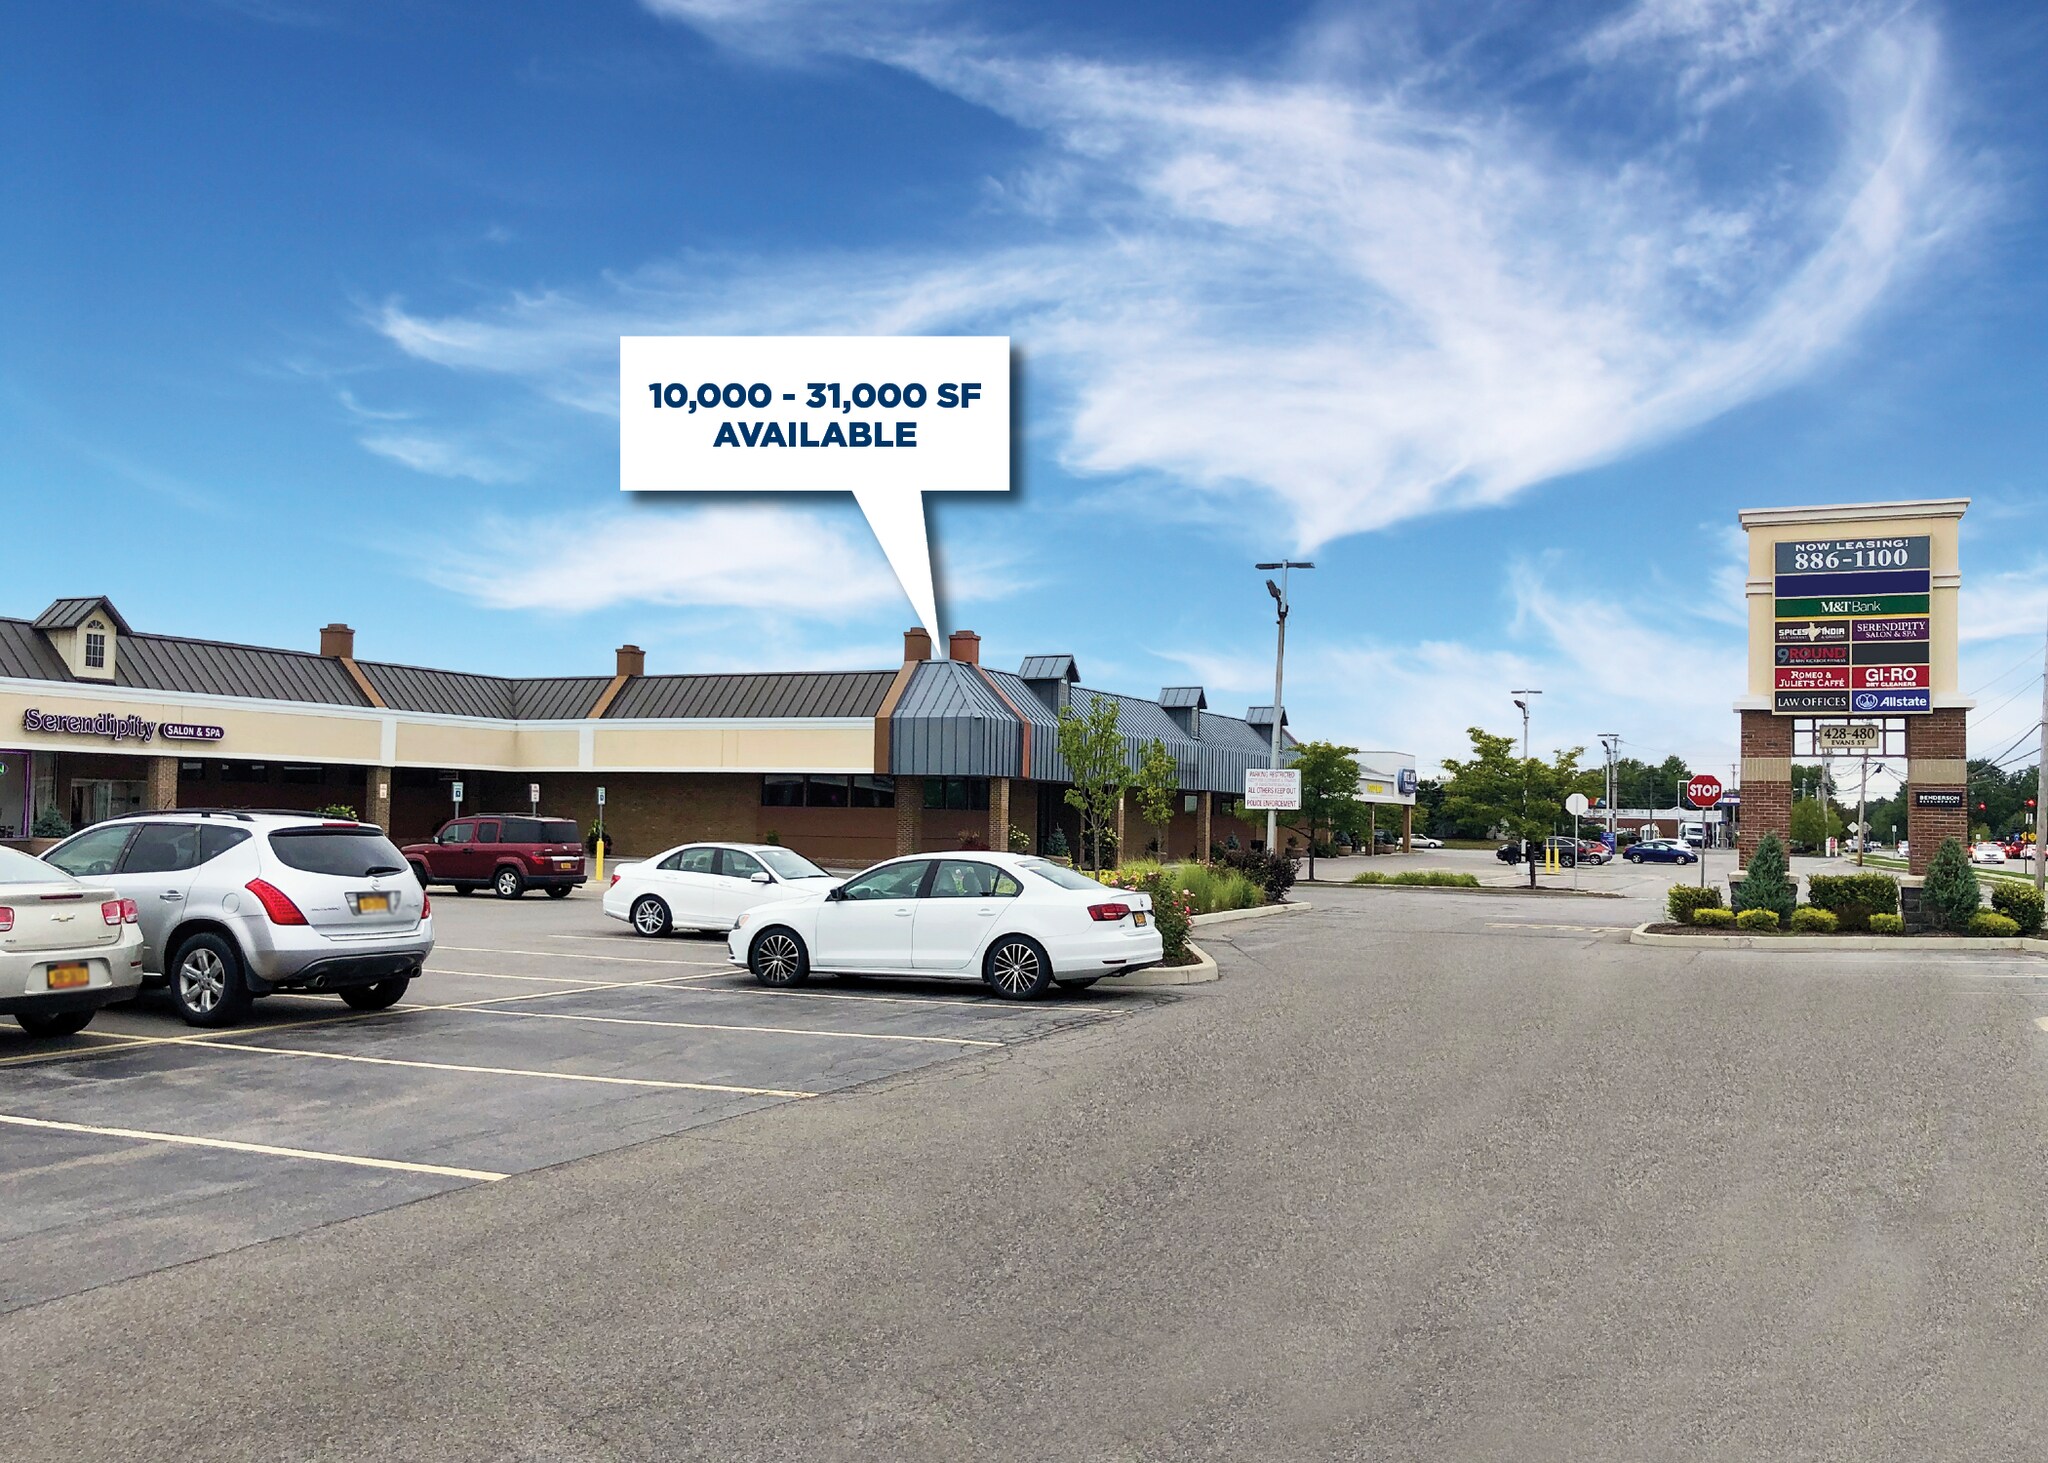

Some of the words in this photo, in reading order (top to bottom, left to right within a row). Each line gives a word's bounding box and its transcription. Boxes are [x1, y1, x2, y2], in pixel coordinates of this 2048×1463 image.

[1795, 543, 1831, 552] NOW
[1836, 539, 1909, 550] LEASING!
[1795, 548, 1909, 570] 886-1100
[1821, 601, 1851, 613] M&T
[1852, 600, 1881, 612] Bank
[1778, 628, 1809, 636] SPICES
[1857, 621, 1926, 632] SERENDIPITY
[1866, 631, 1892, 639] SALON
[1902, 630, 1917, 638] SPA
[1791, 671, 1823, 679] ROMEO
[1825, 671, 1832, 679] &
[1865, 667, 1917, 682] GI-RO
[1779, 679, 1815, 687] JULIET'S
[1817, 678, 1845, 687] CAFFÉ
[1778, 697, 1800, 707] LAW
[1802, 697, 1847, 707] OFFICES
[1880, 696, 1927, 707] Allstate
[24, 707, 158, 744] Serendipity
[167, 725, 194, 737] SALON
[196, 727, 203, 737] &
[205, 727, 221, 738] SPA
[1824, 728, 1875, 740] 428-480
[1689, 784, 1720, 797] STOP
